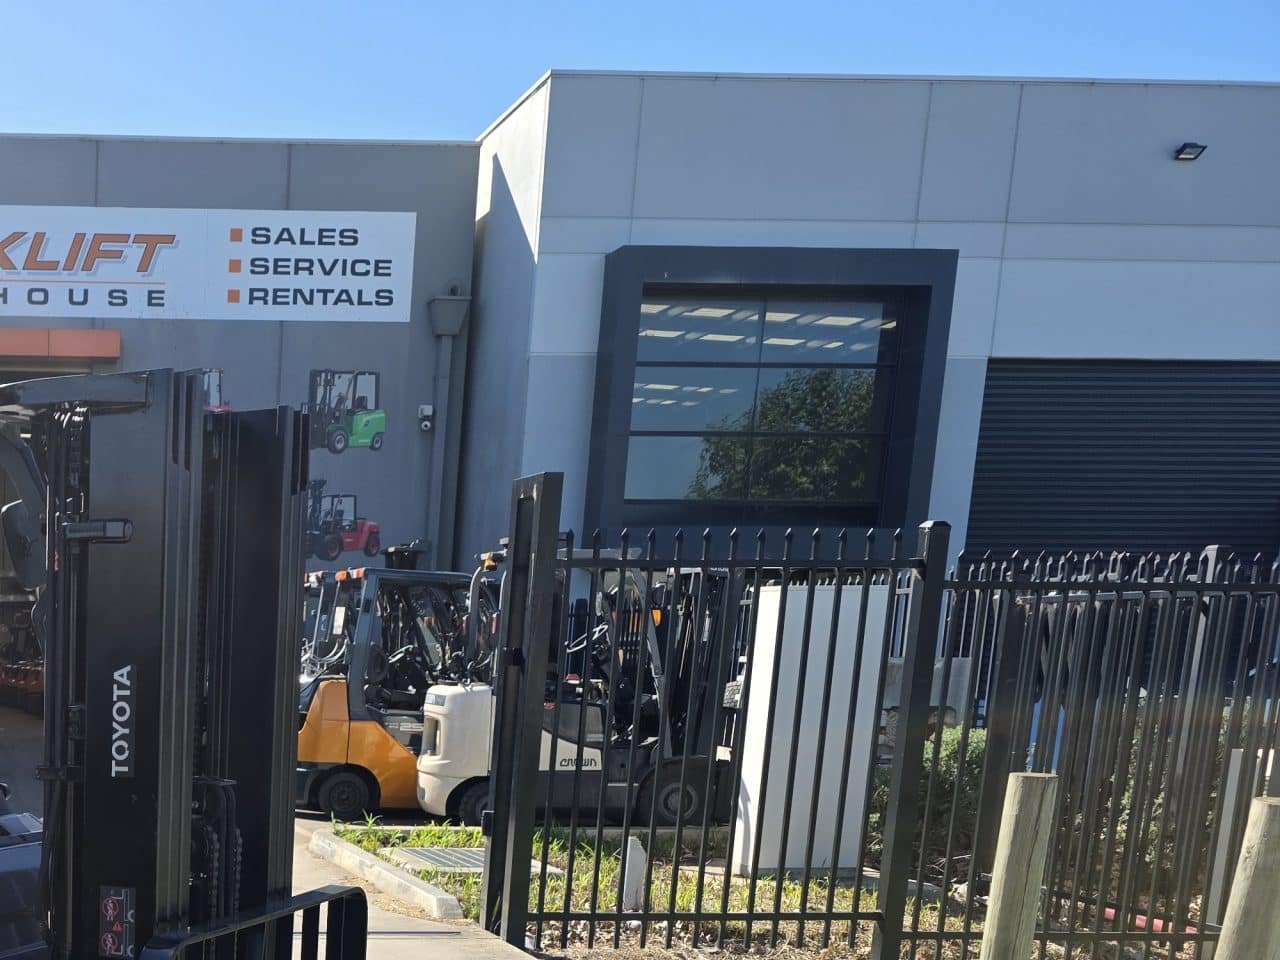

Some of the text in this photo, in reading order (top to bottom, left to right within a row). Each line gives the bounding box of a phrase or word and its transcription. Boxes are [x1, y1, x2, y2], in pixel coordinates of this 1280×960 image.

[251, 227, 359, 246] SALES
[249, 257, 393, 277] SERVICE
[248, 288, 394, 306] RENTALS
[111, 664, 132, 778] TOYOTA
[399, 722, 424, 732] 25
[559, 758, 598, 767] CRWN
